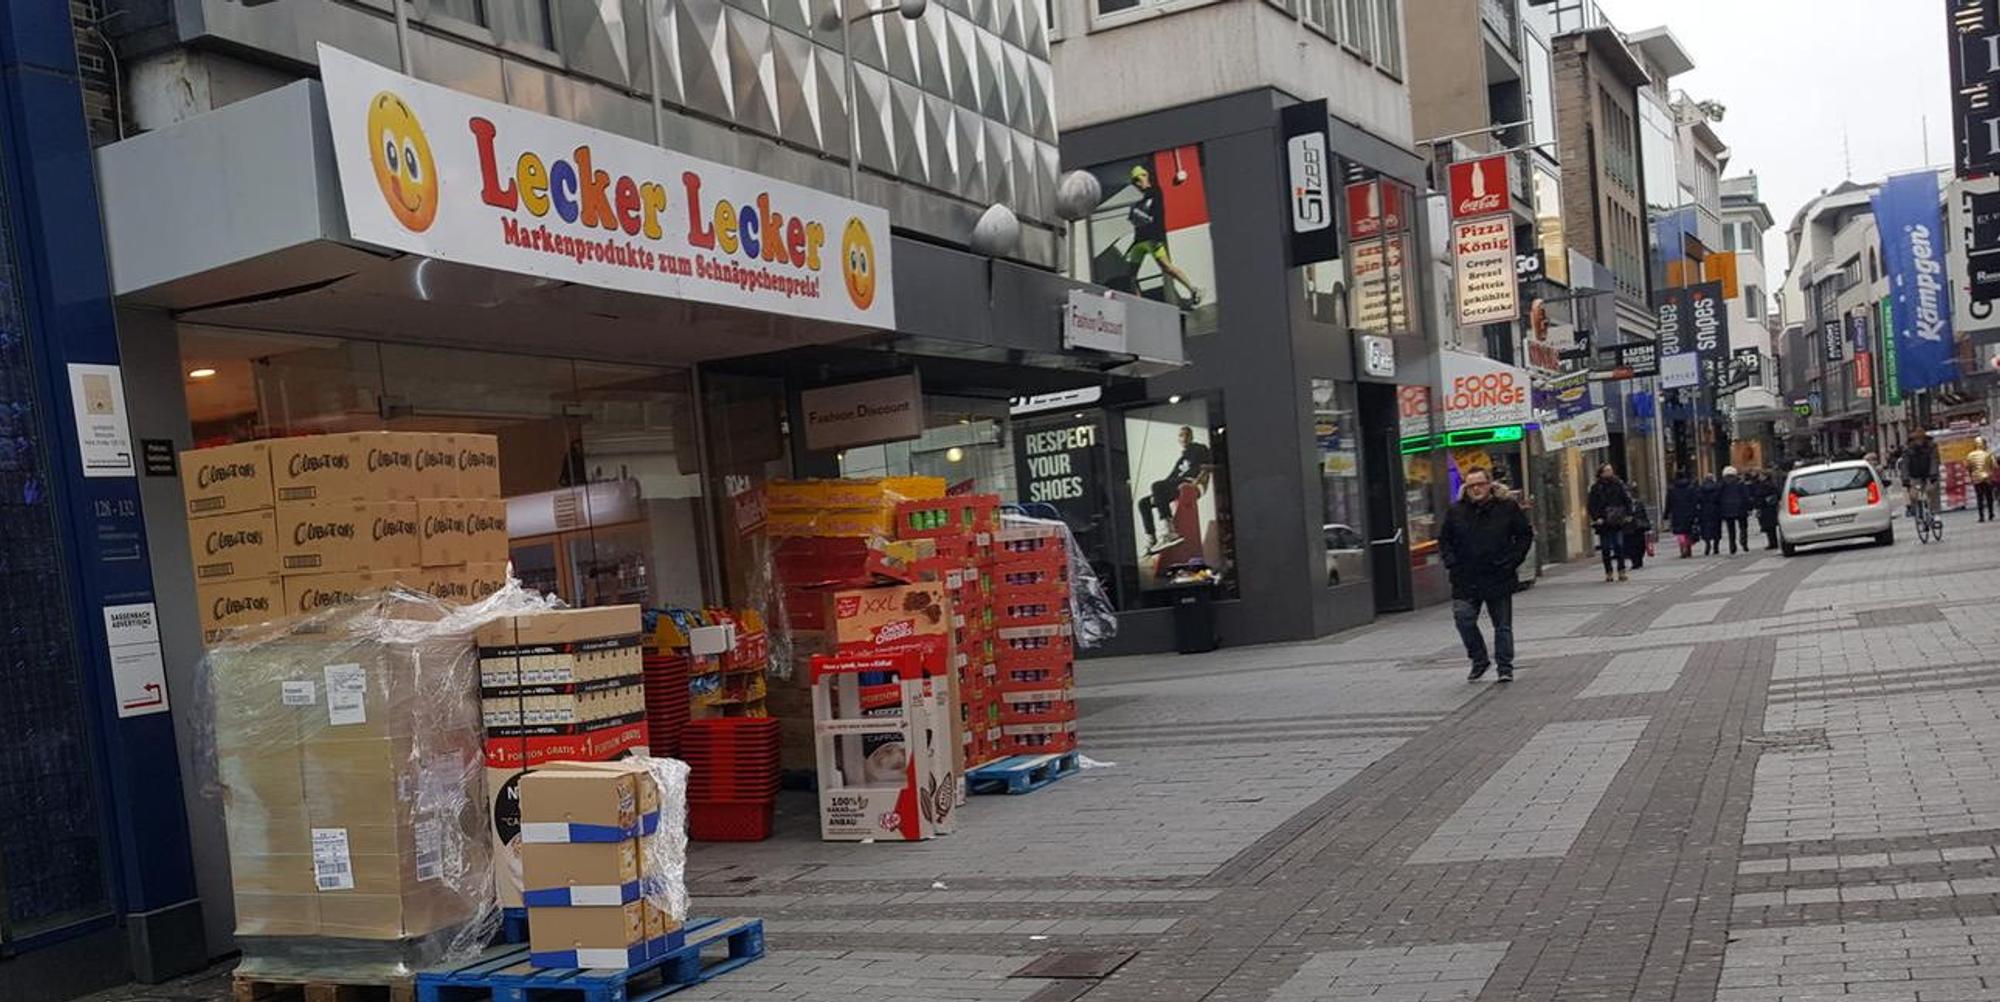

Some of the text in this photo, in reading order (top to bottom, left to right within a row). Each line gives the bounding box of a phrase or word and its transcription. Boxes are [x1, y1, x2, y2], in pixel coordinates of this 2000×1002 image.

[469, 116, 825, 271] Lecker Lecker
[1460, 222, 1504, 239] Pizza
[501, 216, 820, 299] Markenprodukte zum Schnäppchenpreis!
[1458, 238, 1510, 255] König
[1911, 224, 1946, 341] Kämpgen
[1622, 344, 1654, 357] LUSH
[1454, 372, 1513, 394] FOOD
[1445, 386, 1525, 411] LOUNGE
[1026, 424, 1097, 455] RESPECT
[1027, 453, 1071, 479] YOUR
[1030, 477, 1083, 502] SHOES
[864, 595, 898, 616] XXL
[546, 744, 575, 756] GRATIS
